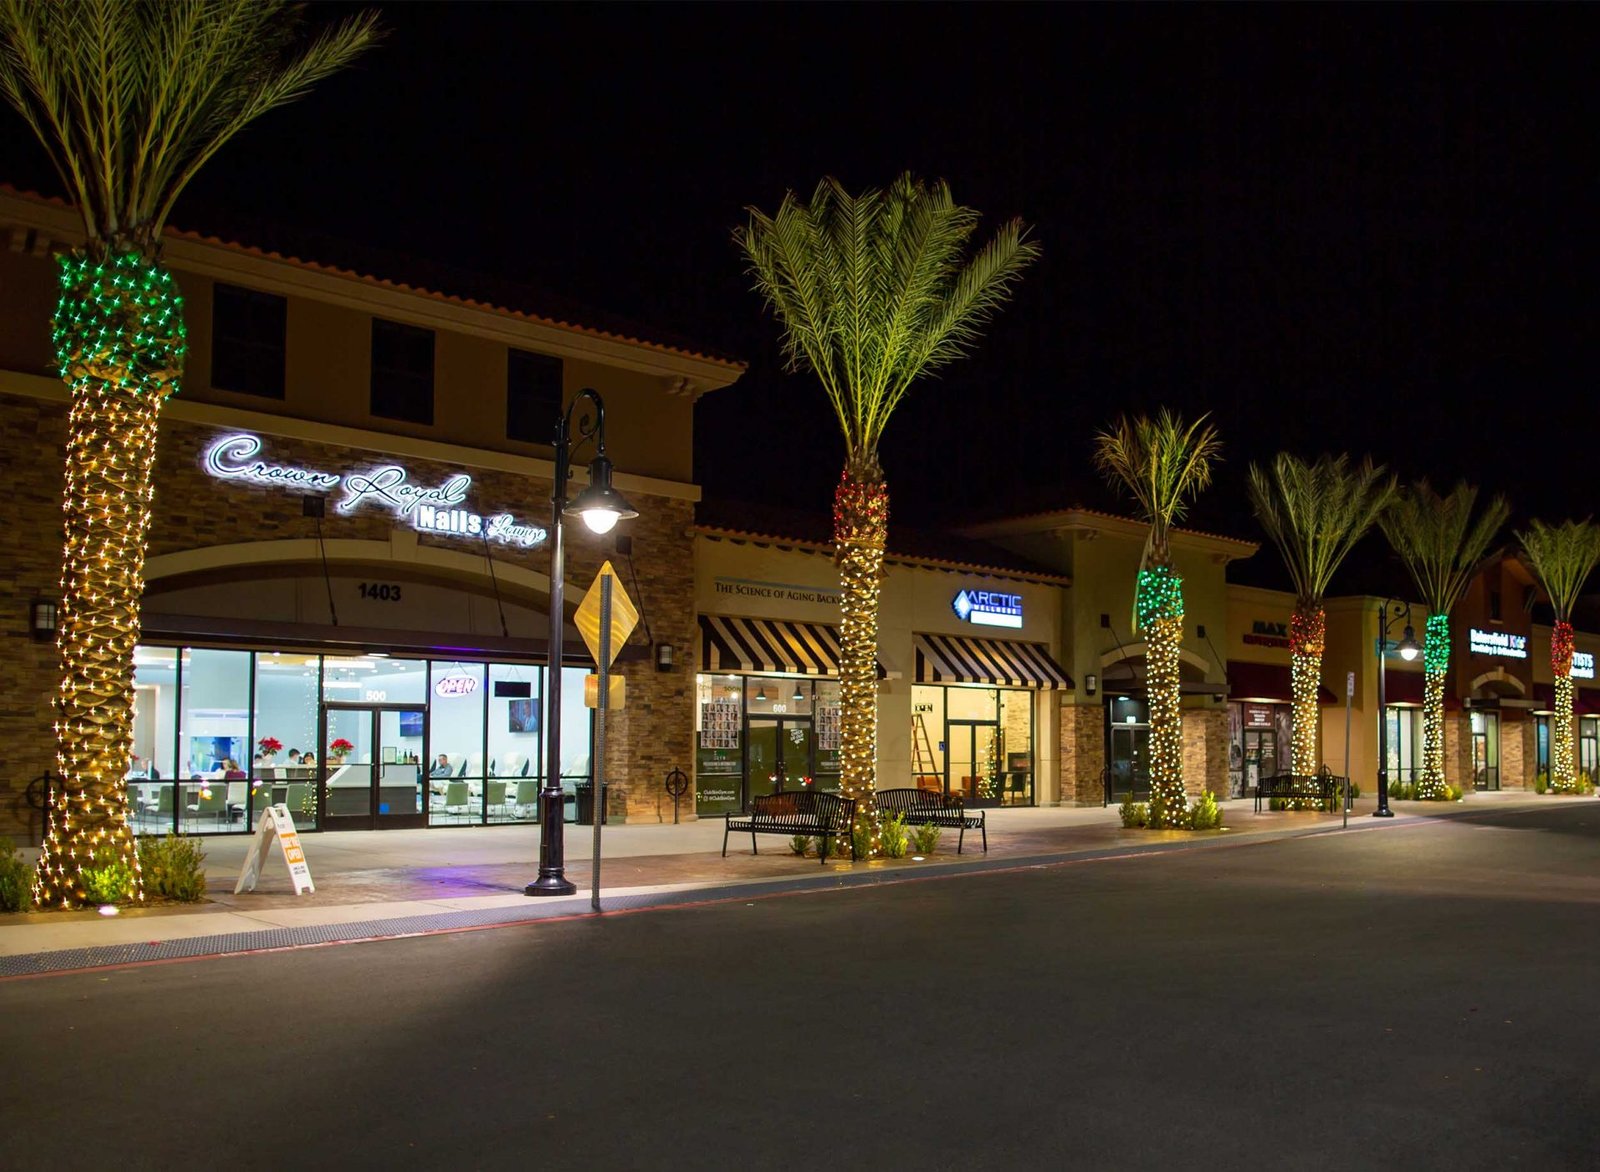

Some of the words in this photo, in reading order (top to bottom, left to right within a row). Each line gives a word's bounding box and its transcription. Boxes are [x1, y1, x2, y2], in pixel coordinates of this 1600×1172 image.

[208, 434, 340, 487] Crown
[340, 466, 471, 513] Royal
[420, 505, 481, 533] Nails
[358, 583, 401, 601] 1403
[715, 582, 733, 593] THE
[735, 585, 772, 597] SCIENCE
[773, 590, 784, 598] OF
[787, 592, 815, 602] AGING
[968, 590, 1022, 608] ARCTIC
[1252, 620, 1288, 637] MAX
[439, 678, 475, 693] OPEN
[367, 690, 386, 701] 500
